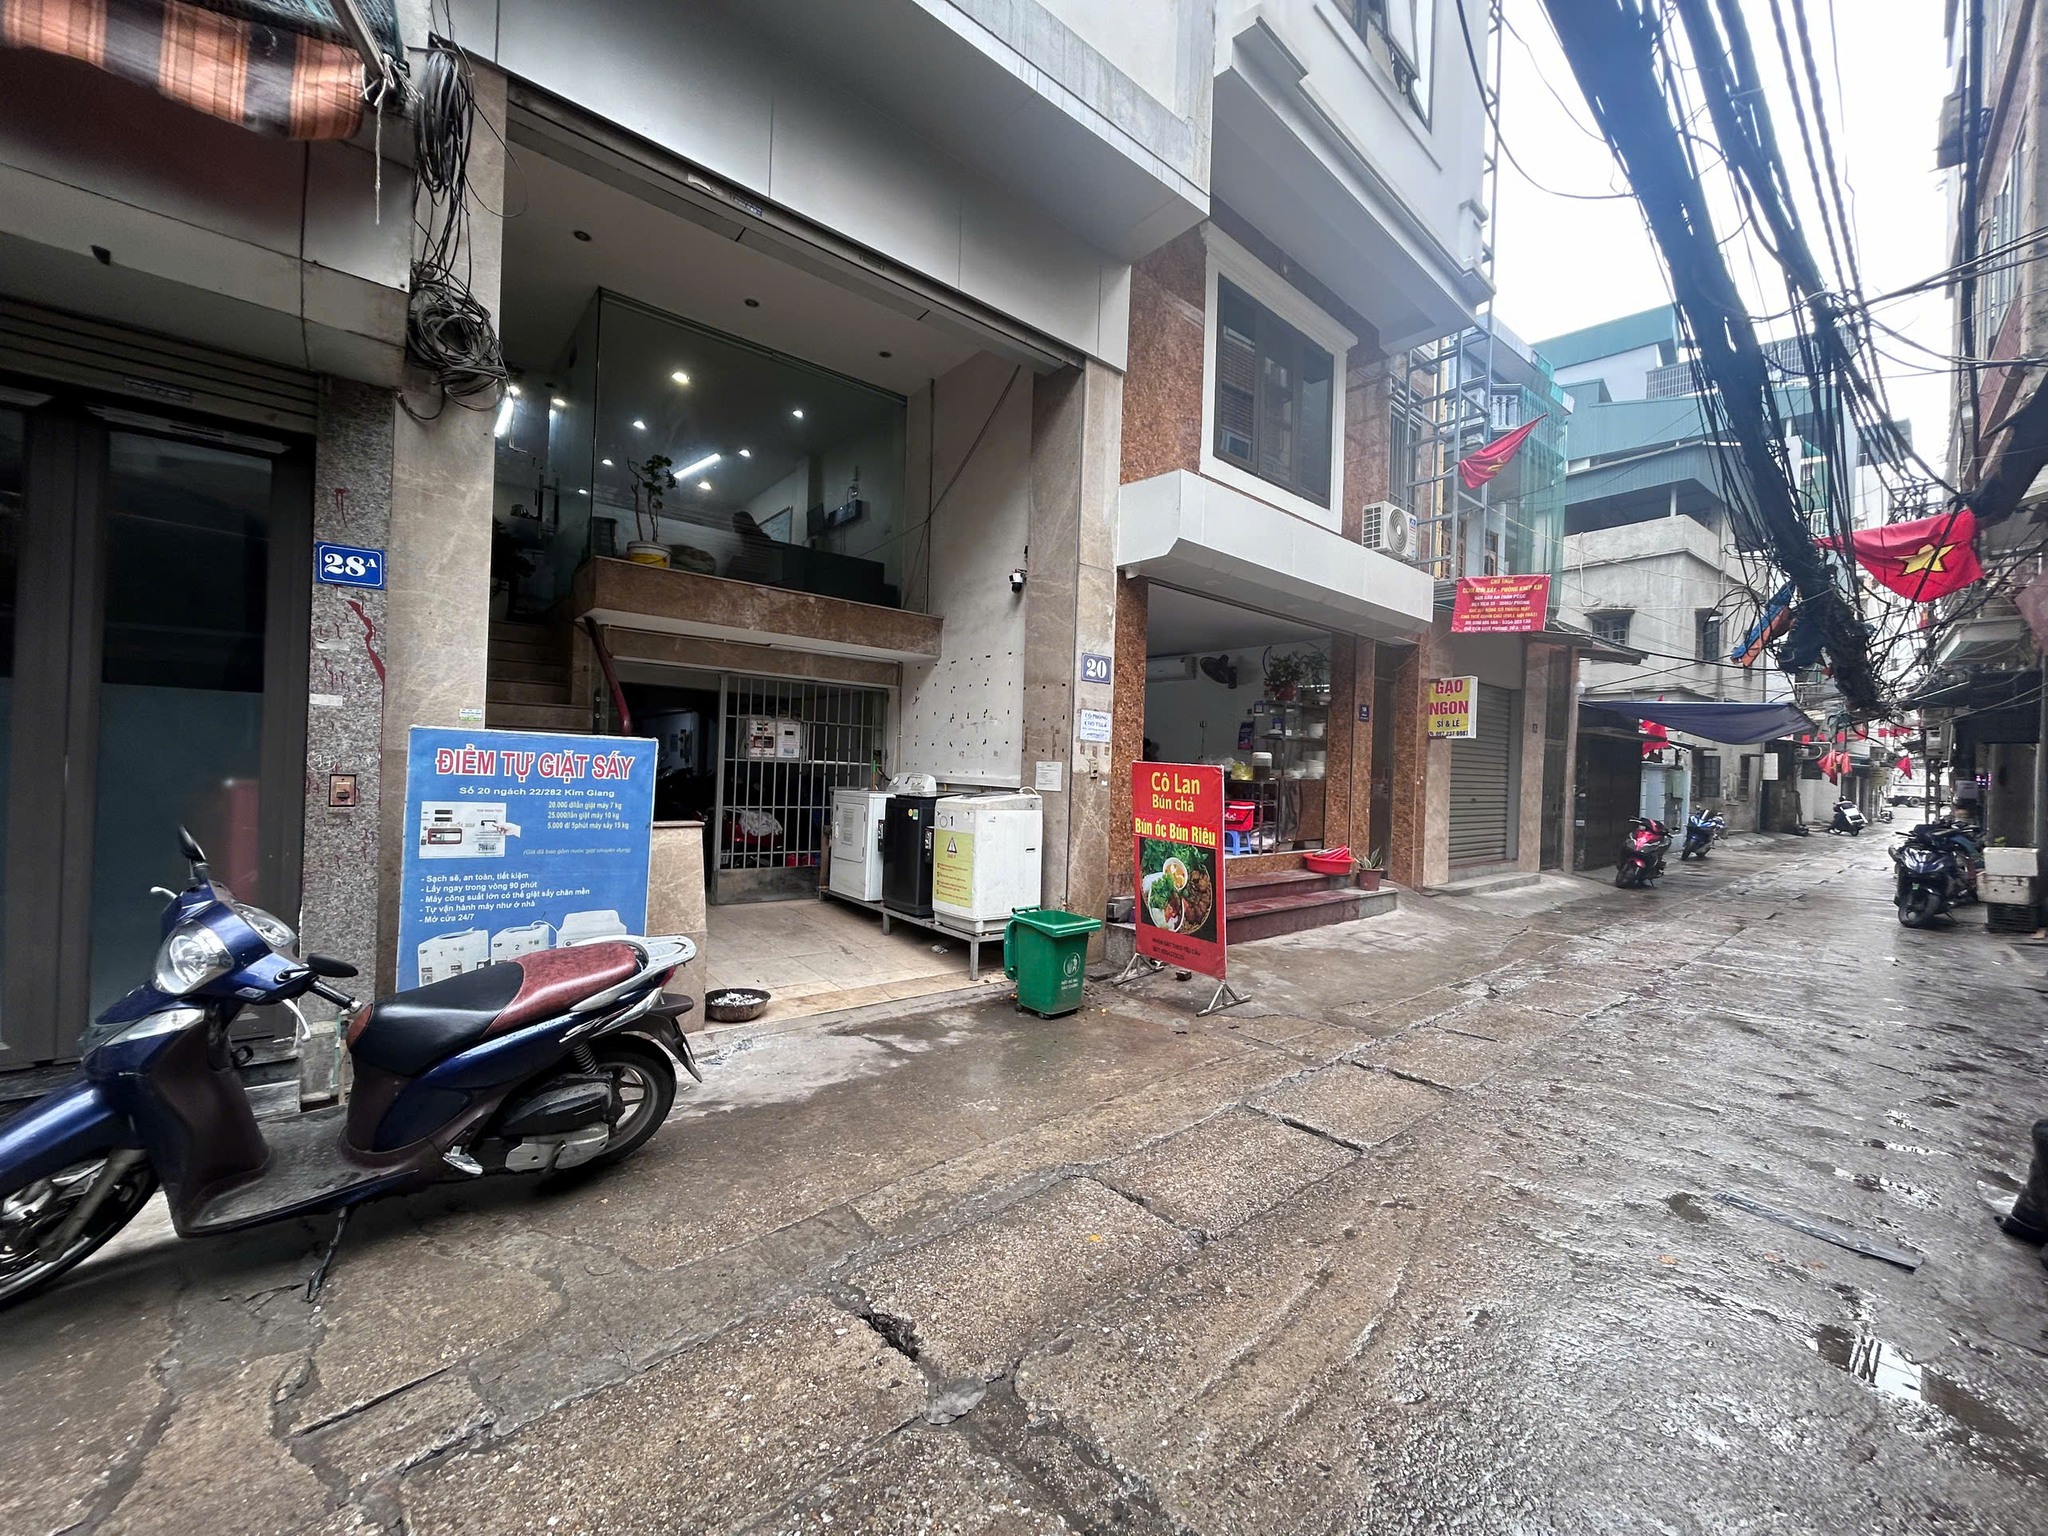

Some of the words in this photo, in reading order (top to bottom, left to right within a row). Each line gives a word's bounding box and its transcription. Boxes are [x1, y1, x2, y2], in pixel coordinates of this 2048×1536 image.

[1086, 658, 1107, 678] 20
[1429, 700, 1468, 715] NGON
[436, 744, 495, 776] ĐIỂM
[501, 751, 535, 782] TỰ
[538, 750, 590, 784] GIẶT
[592, 750, 635, 779] SẤY
[1151, 772, 1170, 792] Cô
[1174, 773, 1200, 794] Lan
[494, 787, 526, 797] ngách
[529, 788, 562, 796] 22/282
[586, 789, 615, 798] Giang
[1152, 794, 1172, 810] Bún
[1175, 796, 1194, 812] chả
[1135, 818, 1152, 835] Bún
[1155, 819, 1166, 838] ốc
[1170, 822, 1188, 841] Bún
[1192, 826, 1216, 846] Riêu
[426, 875, 447, 883] Sạch
[426, 884, 441, 893] Lấy
[426, 895, 442, 903] Máy
